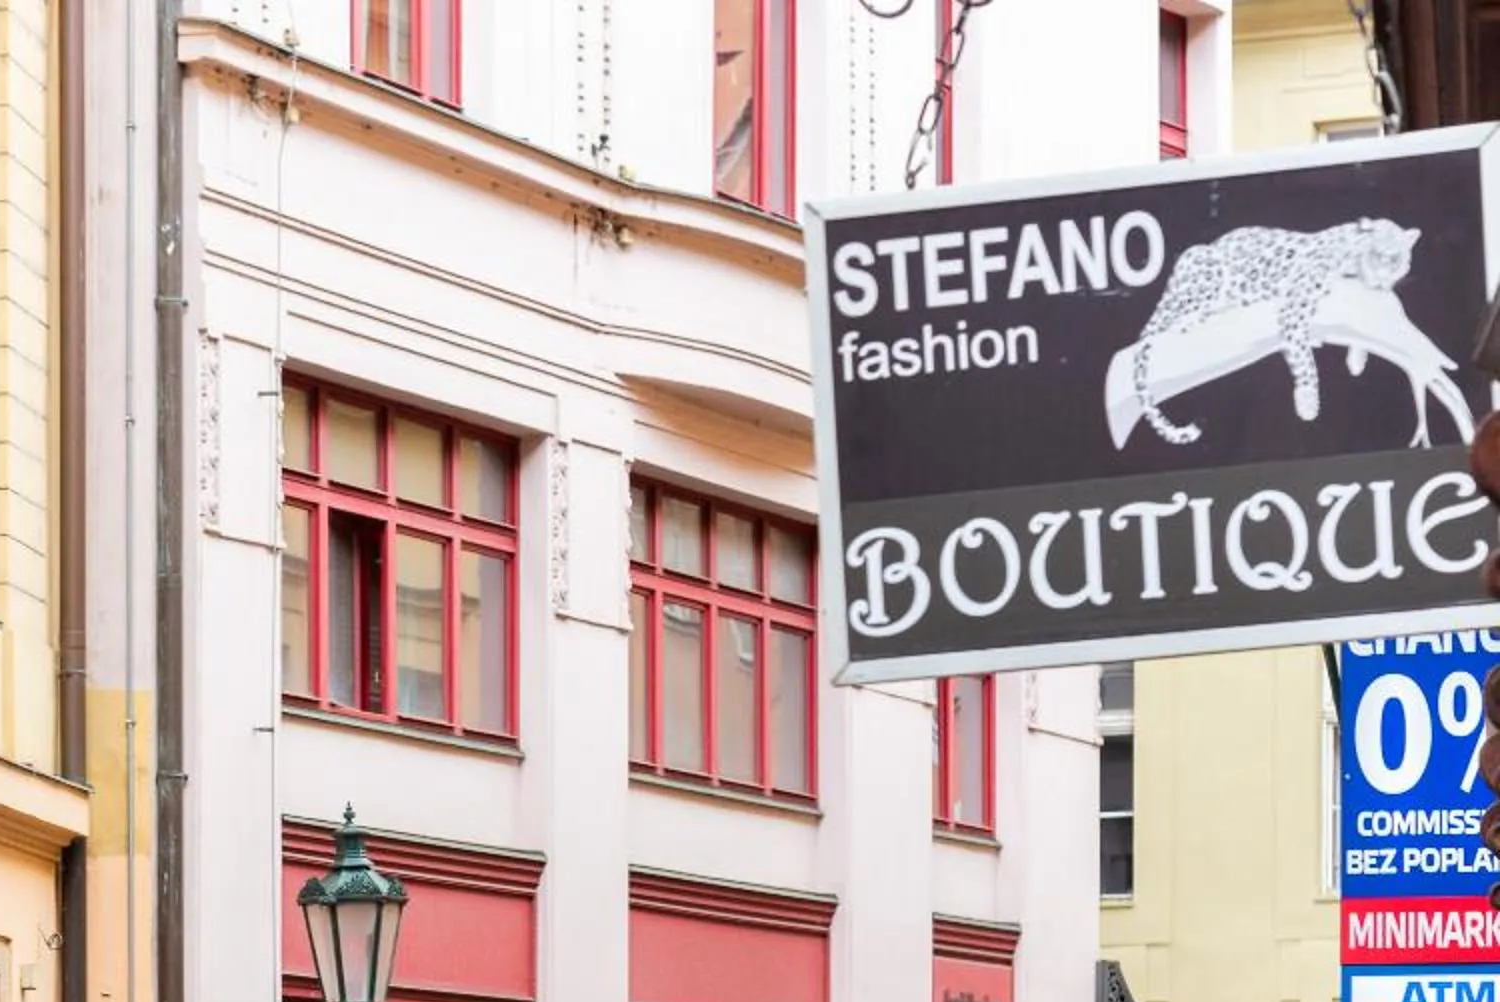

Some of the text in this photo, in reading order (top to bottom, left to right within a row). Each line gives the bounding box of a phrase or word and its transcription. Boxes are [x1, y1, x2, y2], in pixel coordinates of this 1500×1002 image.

[833, 210, 1164, 317] STEFANO
[838, 321, 1039, 382] fashion
[846, 471, 1490, 636] BOUTIQUE
[1357, 809, 1485, 837] COMMISS
[1347, 849, 1397, 874] BEZ
